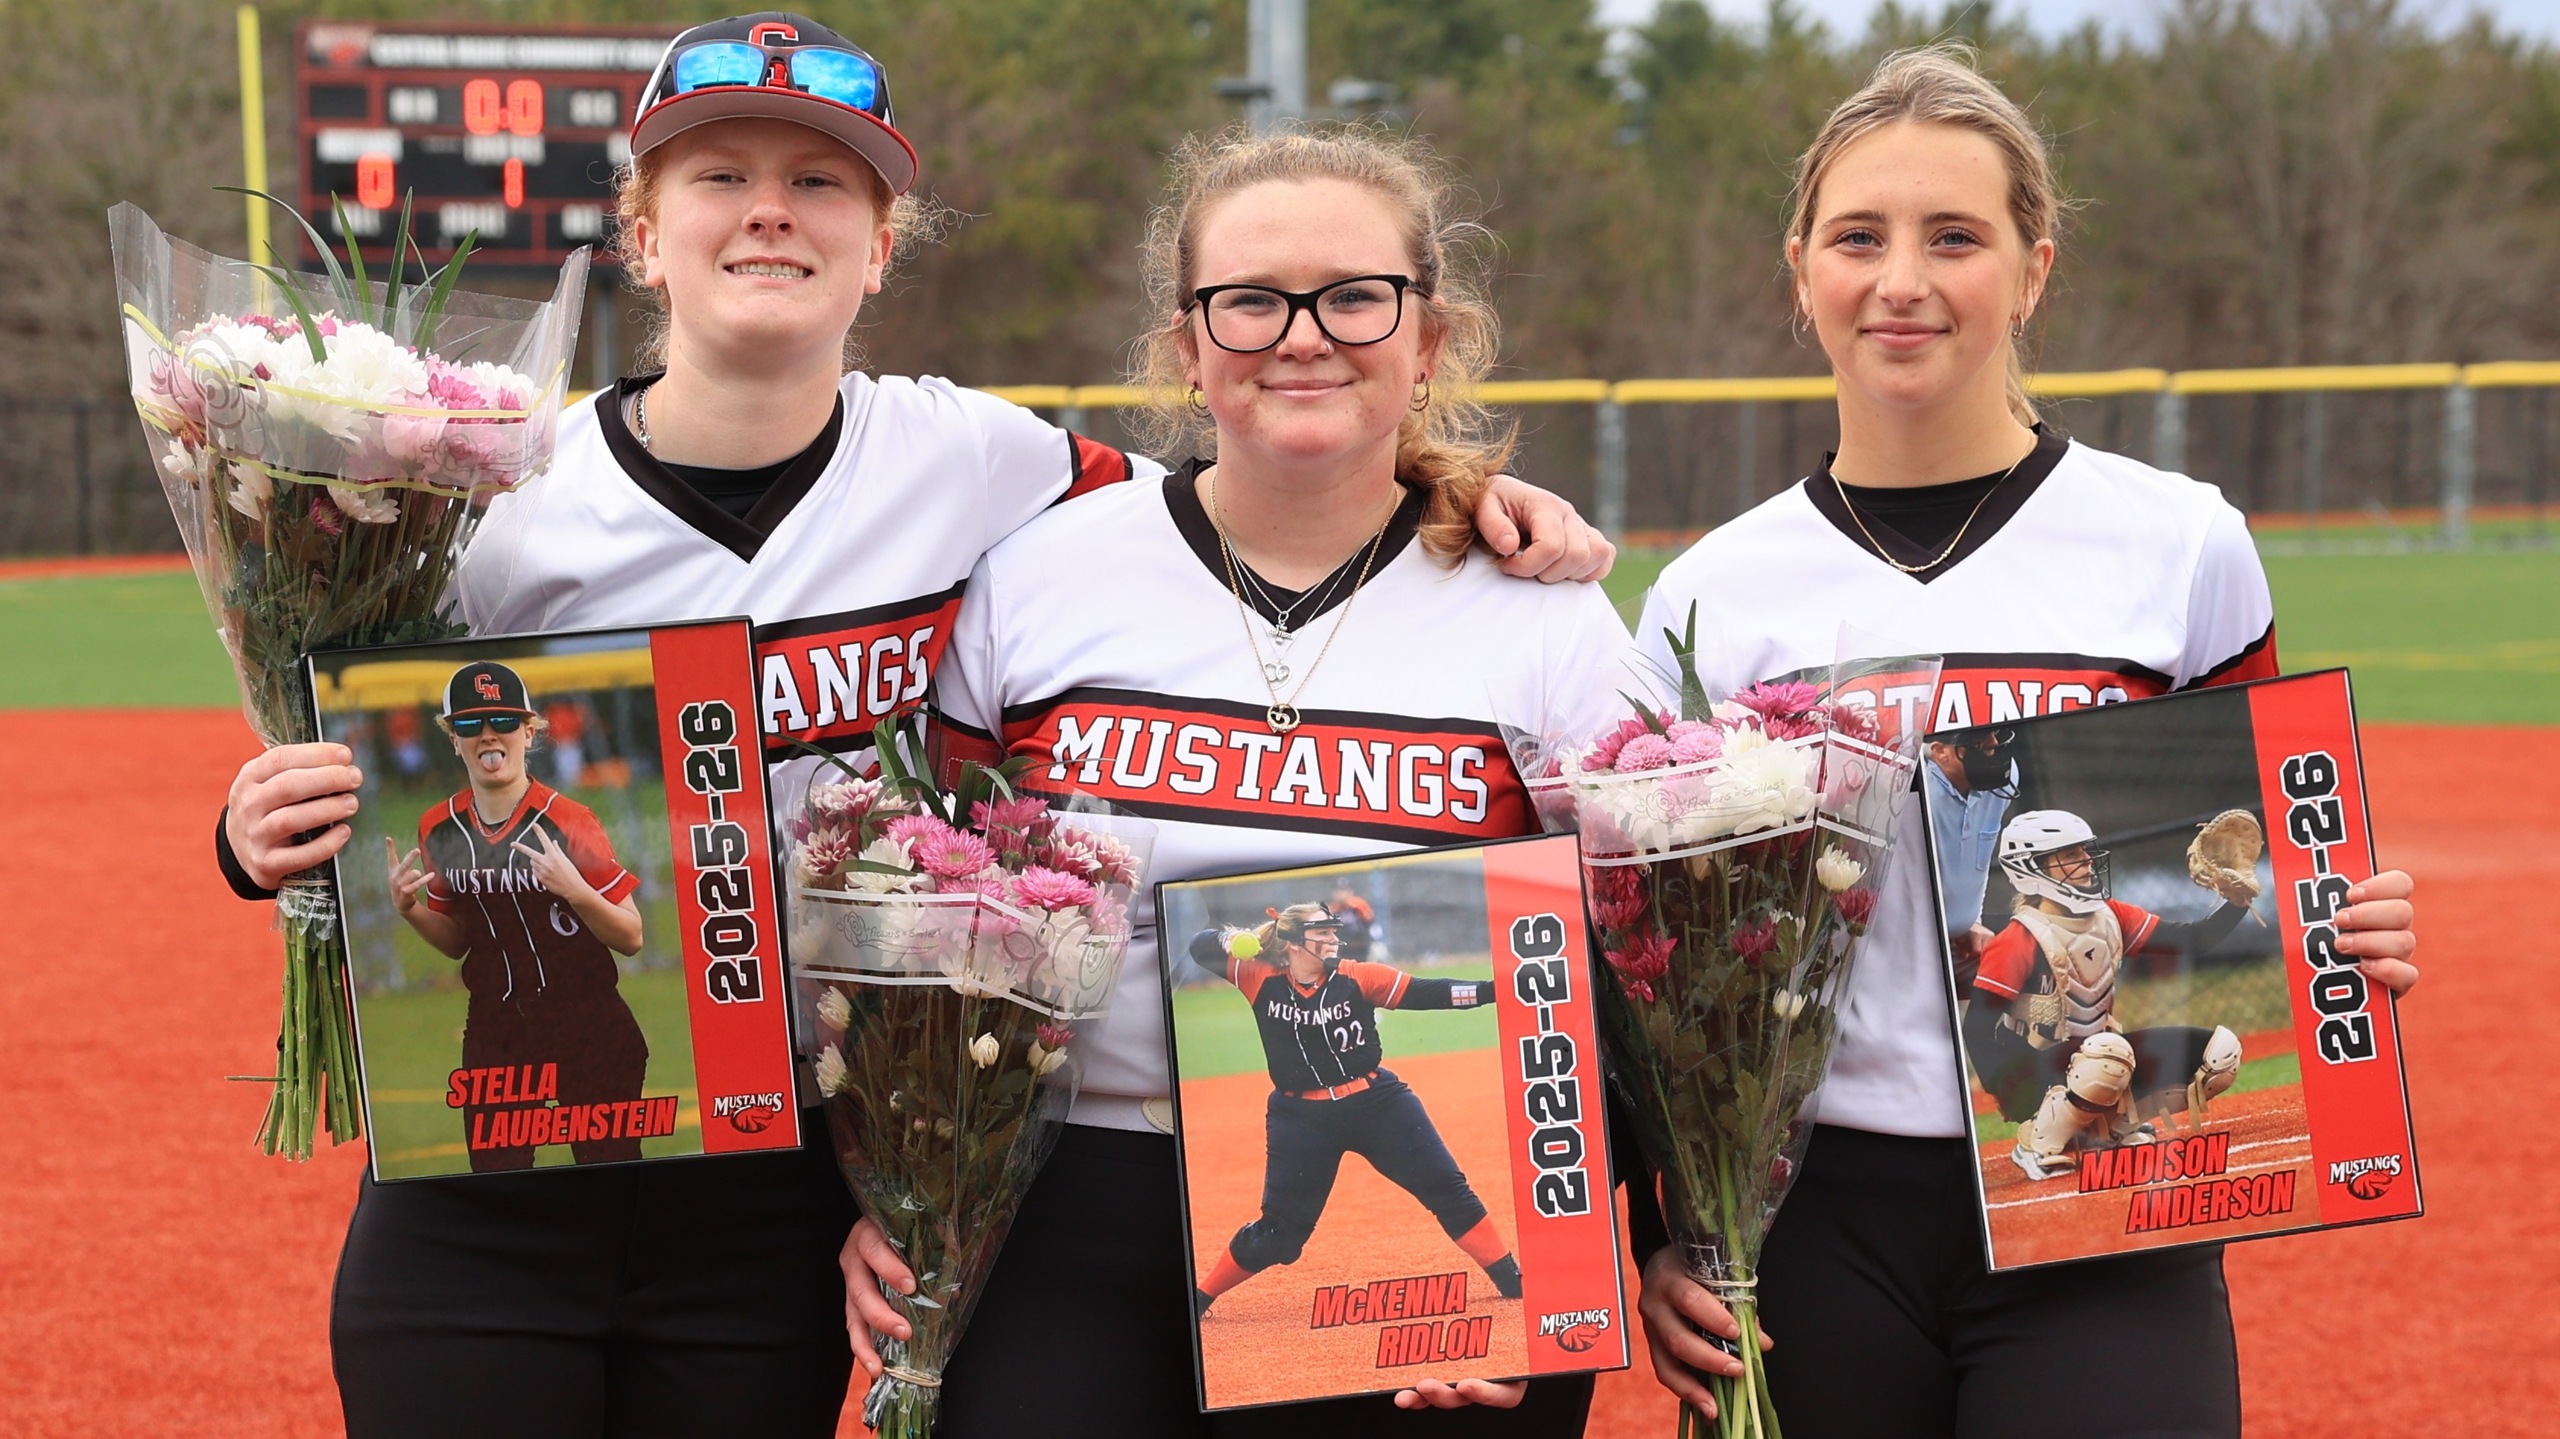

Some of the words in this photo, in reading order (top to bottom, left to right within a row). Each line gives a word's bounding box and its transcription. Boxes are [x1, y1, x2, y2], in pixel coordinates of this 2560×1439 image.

[357, 153, 395, 209] 0
[503, 157, 525, 208] 1
[474, 673, 501, 700] CM
[761, 625, 935, 733] ANGS
[1837, 681, 2128, 752] TAN
[1046, 715, 1490, 823] MUSTANGS
[678, 700, 764, 1004] 2025-26
[550, 901, 579, 937] 6
[2279, 750, 2379, 1064] 2025-26
[1267, 1000, 1351, 1025] MUSTANGS
[1333, 1020, 1365, 1052] 22
[446, 1062, 559, 1108] STELLA
[1509, 912, 1591, 1218] 2025-26
[470, 1095, 679, 1151] LAUBENSTEIN
[713, 1092, 784, 1118] MUSTANGS
[2079, 1131, 2230, 1193] MADISON
[2328, 1154, 2402, 1185] MUSTANGS
[2125, 1170, 2296, 1234] ANDERSON
[1310, 1271, 1468, 1329] McKENNA
[1538, 1308, 1612, 1338] MUSTANGS
[1375, 1315, 1493, 1369] RIDLON
